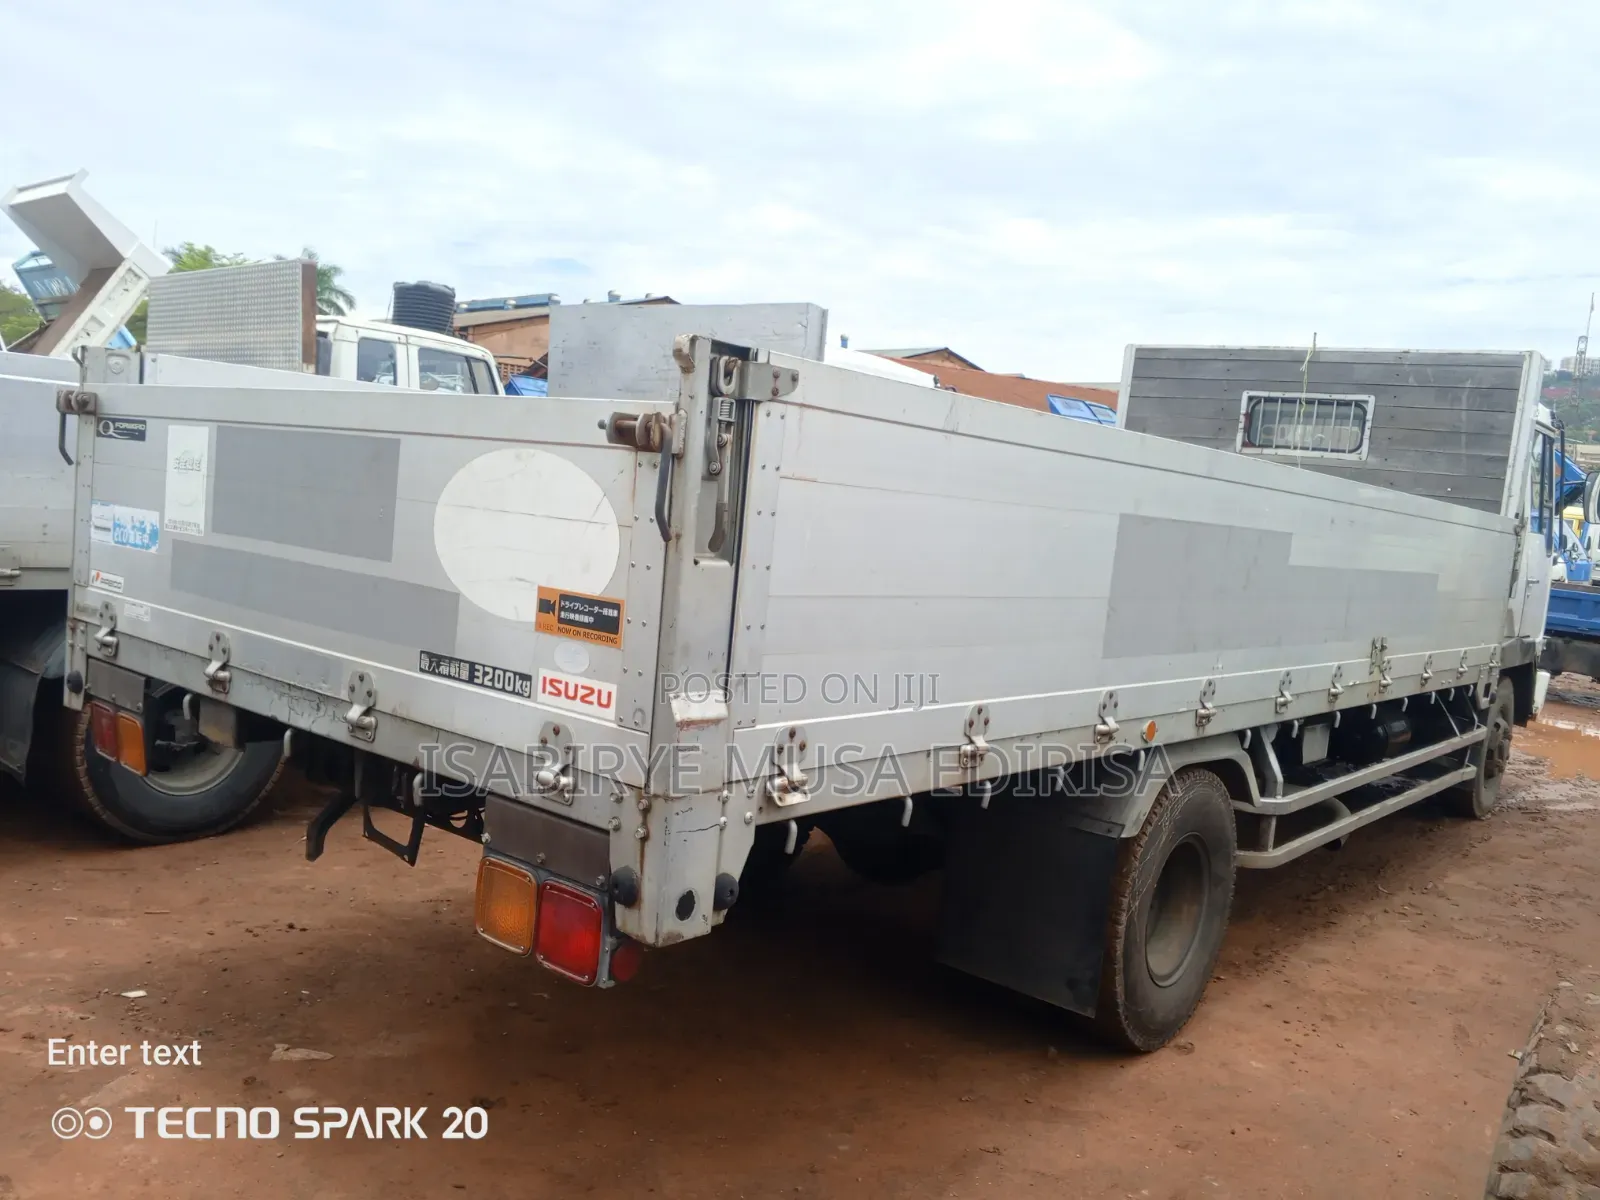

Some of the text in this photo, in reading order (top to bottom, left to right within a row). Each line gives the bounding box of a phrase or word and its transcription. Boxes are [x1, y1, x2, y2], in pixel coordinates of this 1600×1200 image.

[557, 626, 618, 645] NOW ON RECORDING
[474, 664, 531, 697] 3200kg
[542, 675, 612, 709] ISUZU
